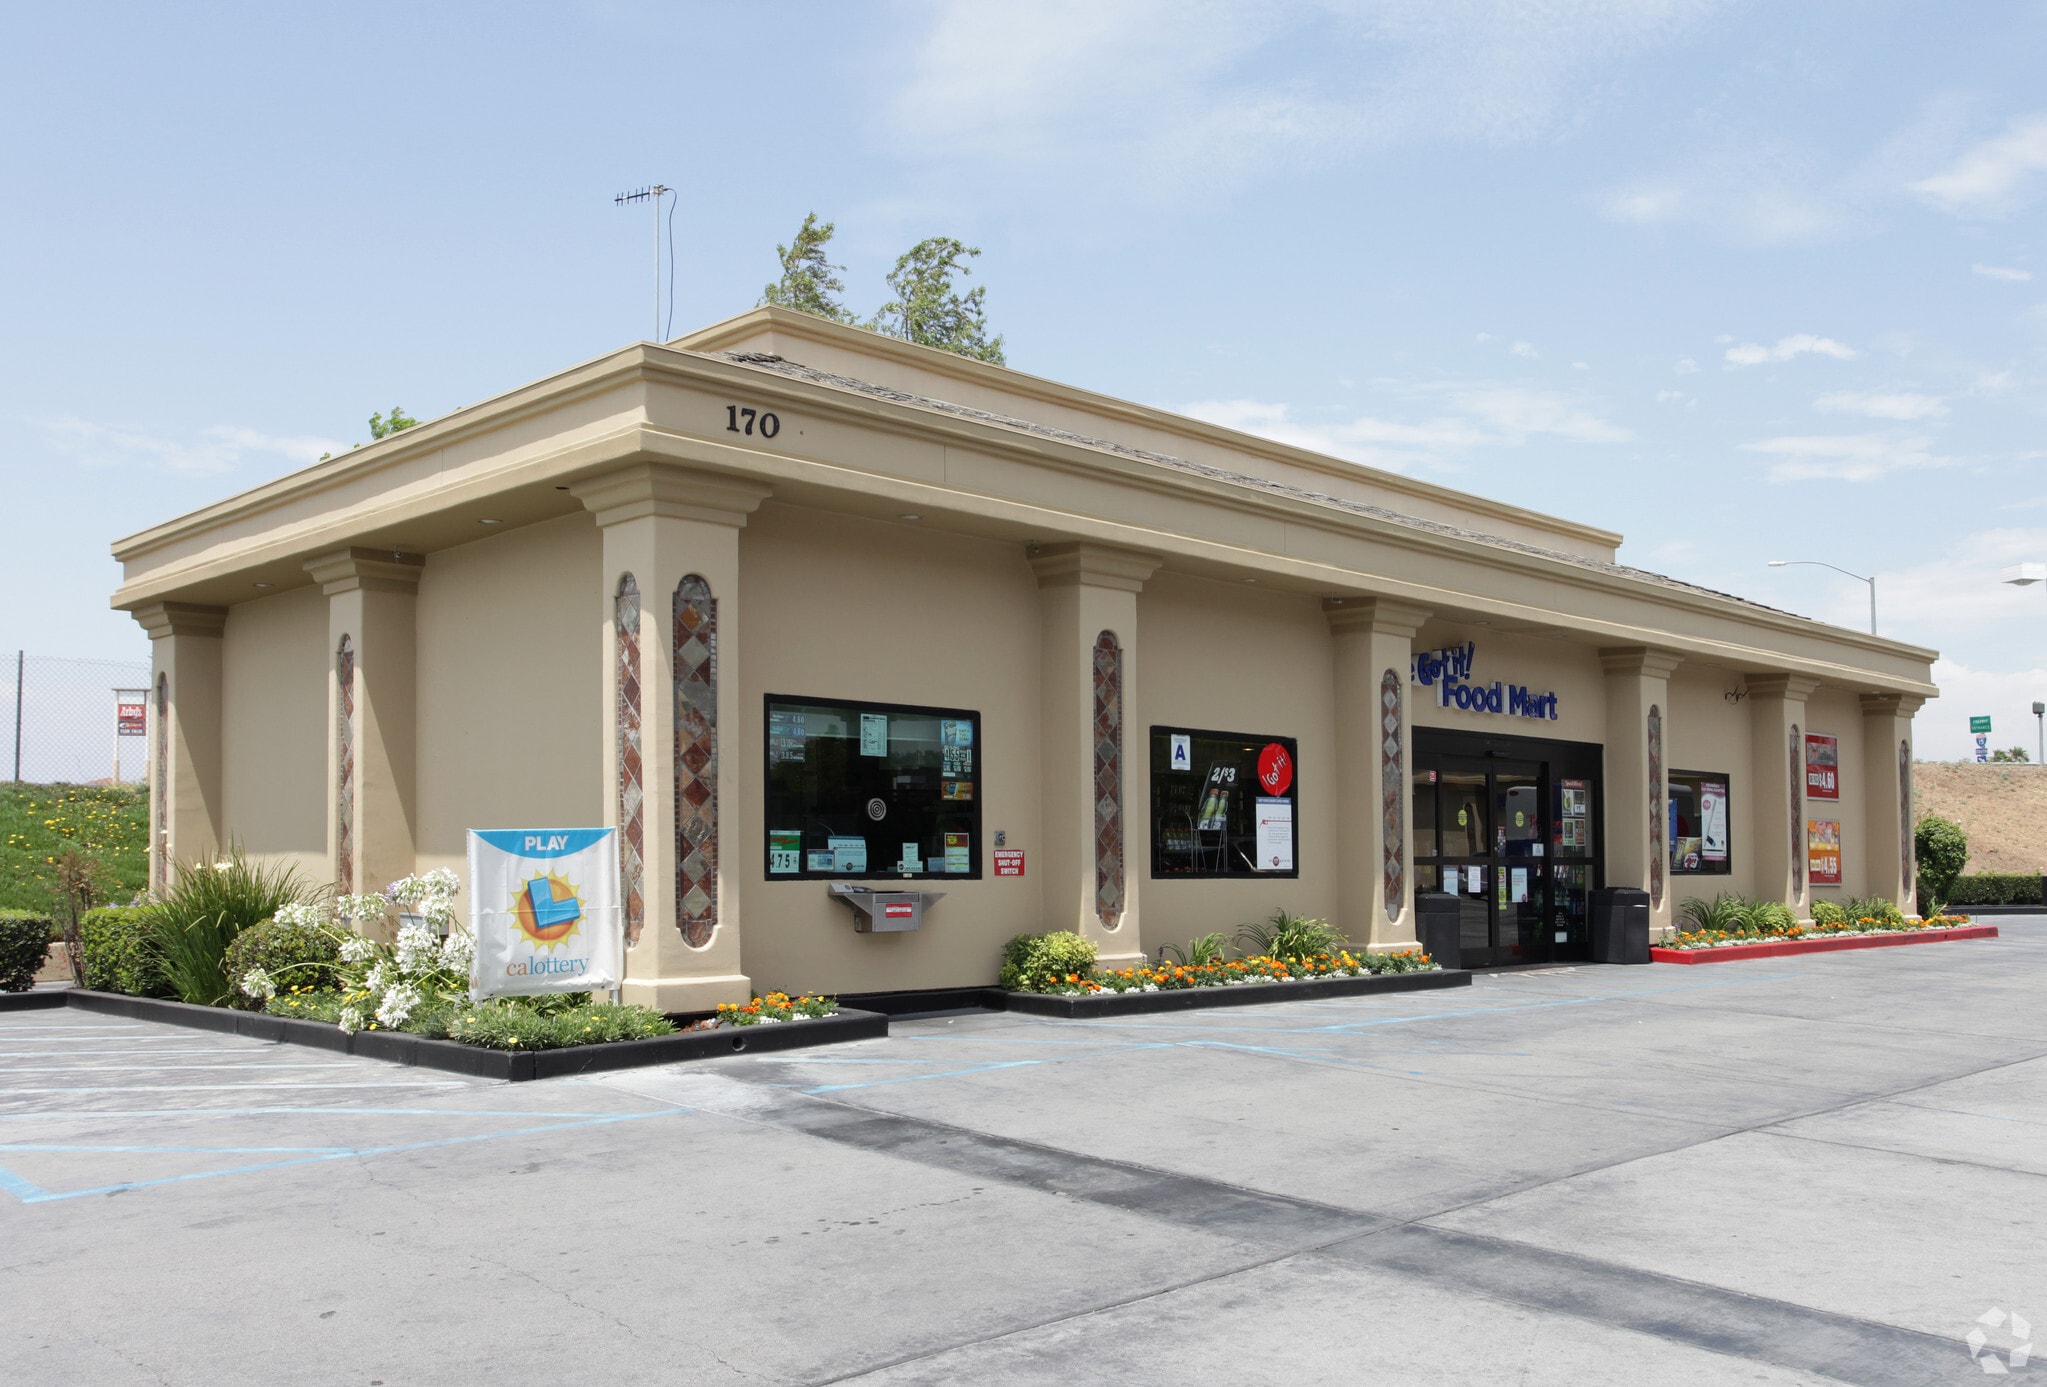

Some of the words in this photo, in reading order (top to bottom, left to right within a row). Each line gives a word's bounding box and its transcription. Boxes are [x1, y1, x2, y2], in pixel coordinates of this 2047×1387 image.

[726, 405, 780, 438] 170
[1418, 647, 1450, 686] Got
[1452, 641, 1475, 680] it!
[1442, 675, 1502, 713] Food
[1509, 684, 1558, 720] Mart
[1175, 744, 1186, 761] A
[1211, 767, 1235, 784] 2/$3
[525, 835, 569, 851] PLAY
[1000, 867, 1019, 875] SWITCH
[506, 956, 590, 977] calottery
